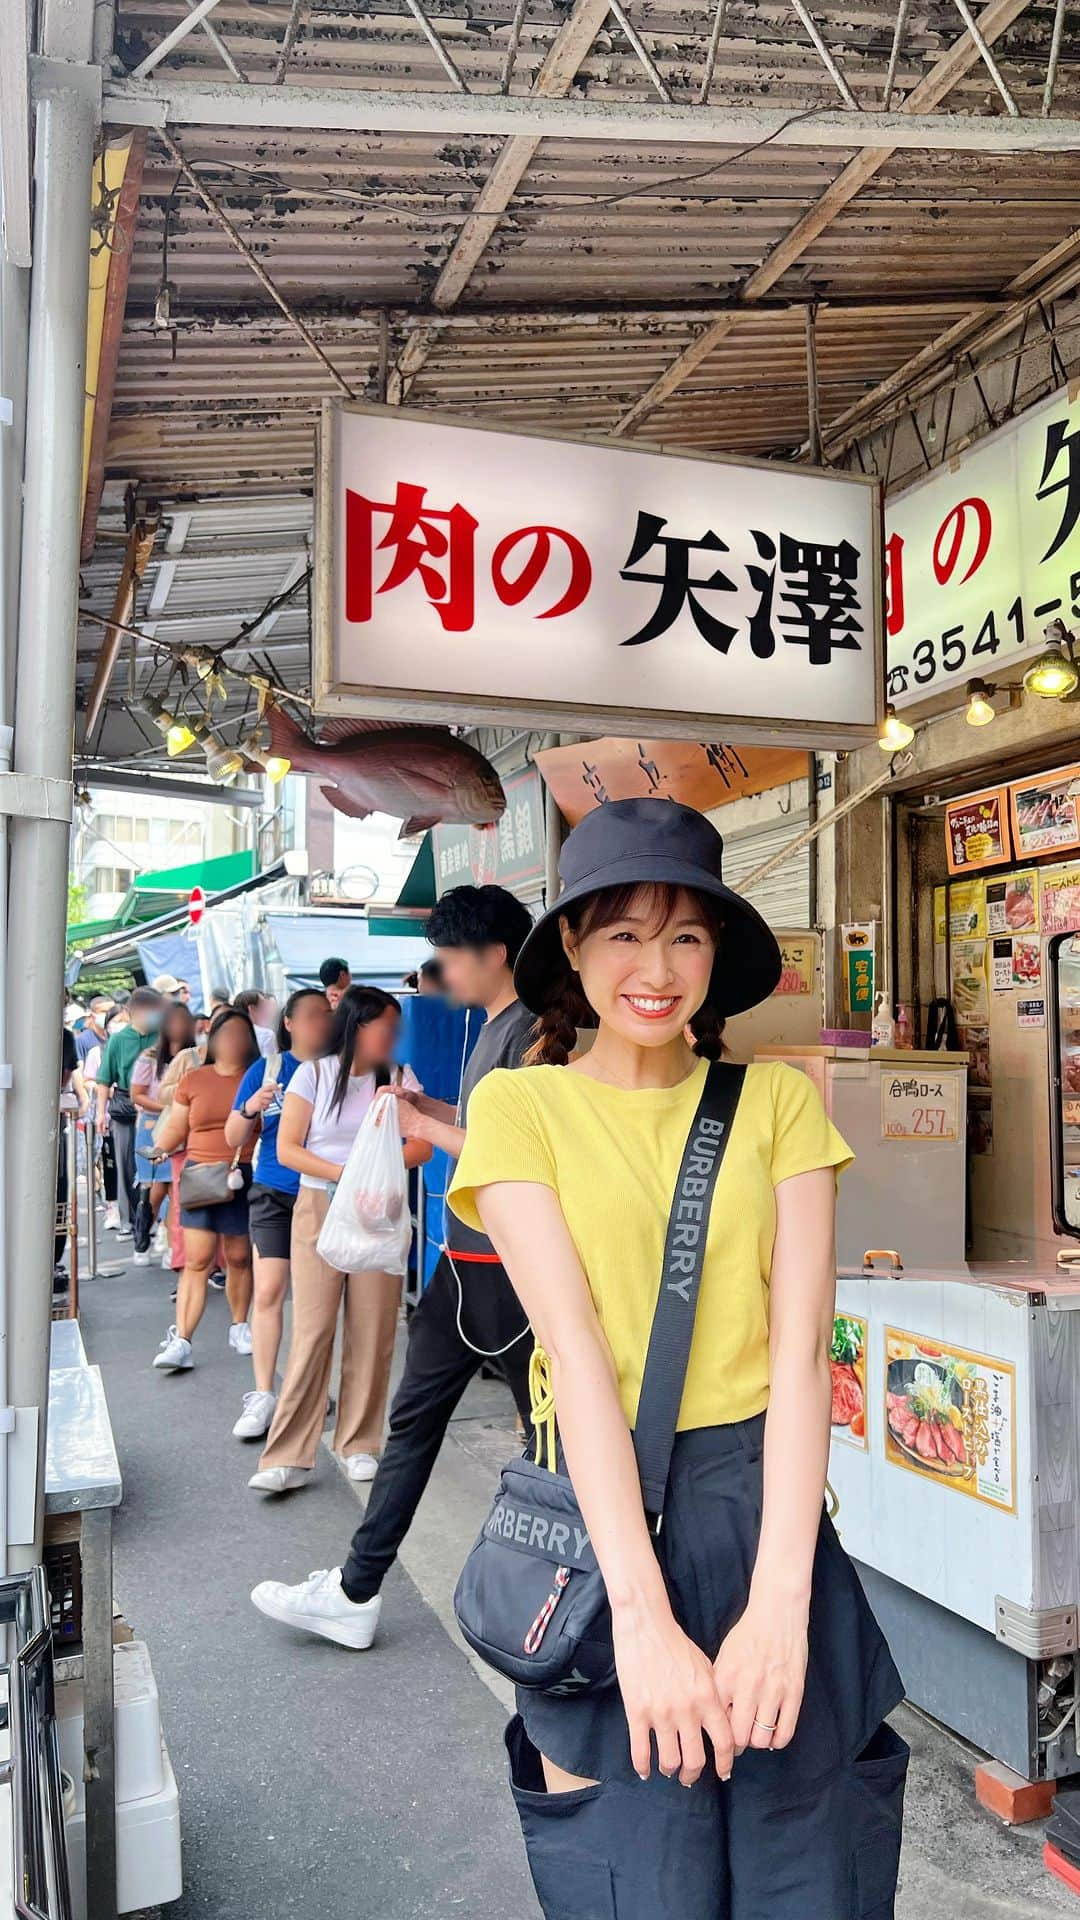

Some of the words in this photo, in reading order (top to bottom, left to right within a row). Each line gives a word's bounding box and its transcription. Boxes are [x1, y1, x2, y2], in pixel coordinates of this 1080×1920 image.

[889, 1078, 943, 1097] 合鴨ロース
[667, 1117, 725, 1302] BURBERRY
[962, 1379, 975, 1479] ローストビーフ
